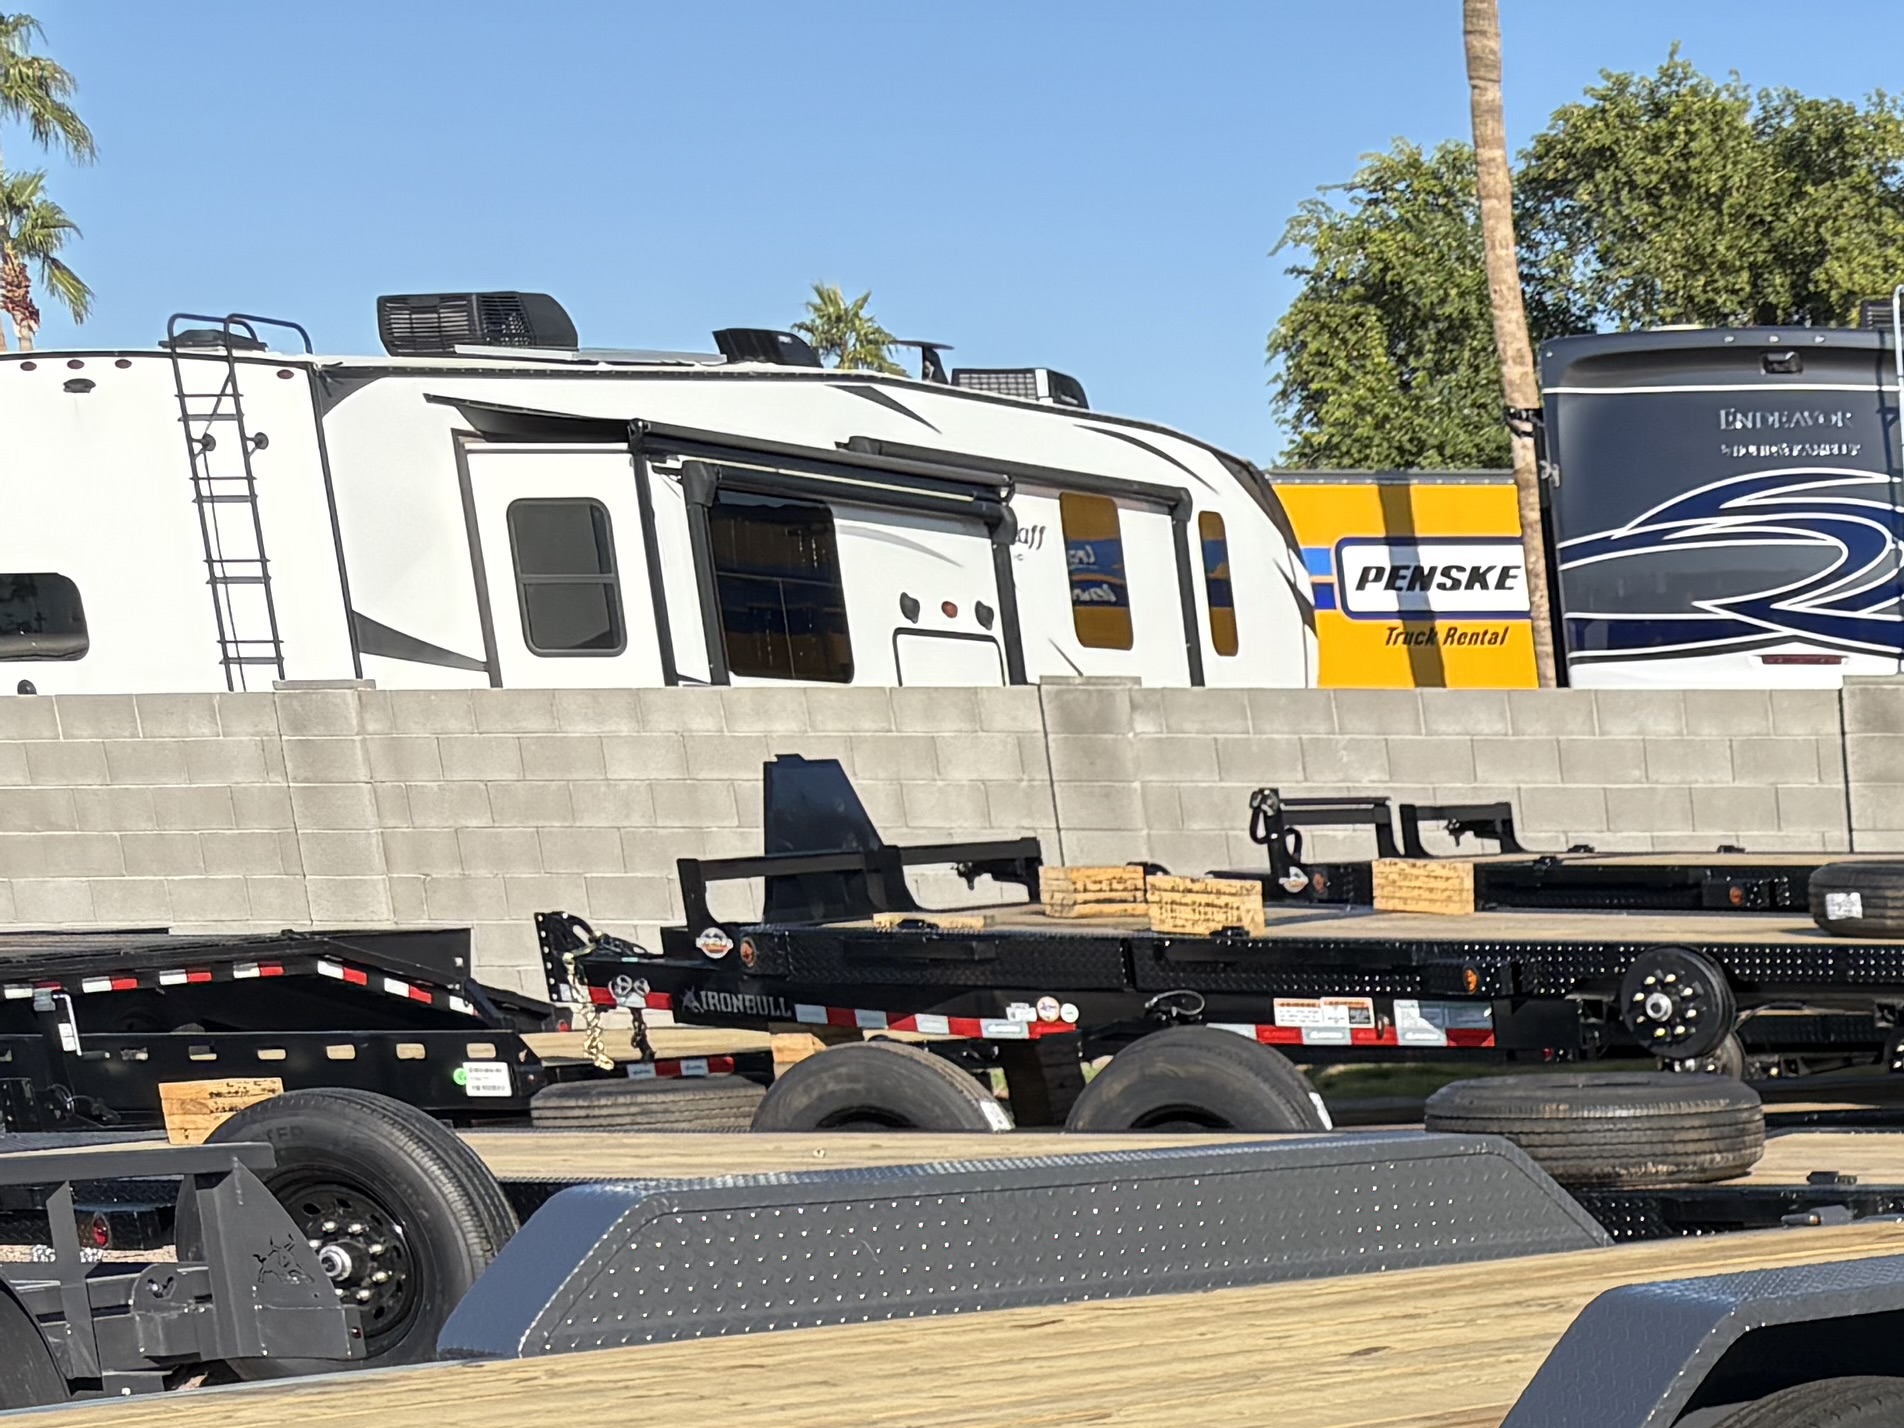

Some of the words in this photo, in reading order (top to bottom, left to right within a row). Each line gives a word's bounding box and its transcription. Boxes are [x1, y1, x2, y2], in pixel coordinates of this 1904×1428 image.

[1356, 565, 1521, 591] PENSKE
[1385, 626, 1437, 646] Truck
[1442, 626, 1509, 646] Rental
[701, 990, 792, 1017] IRONBULL
